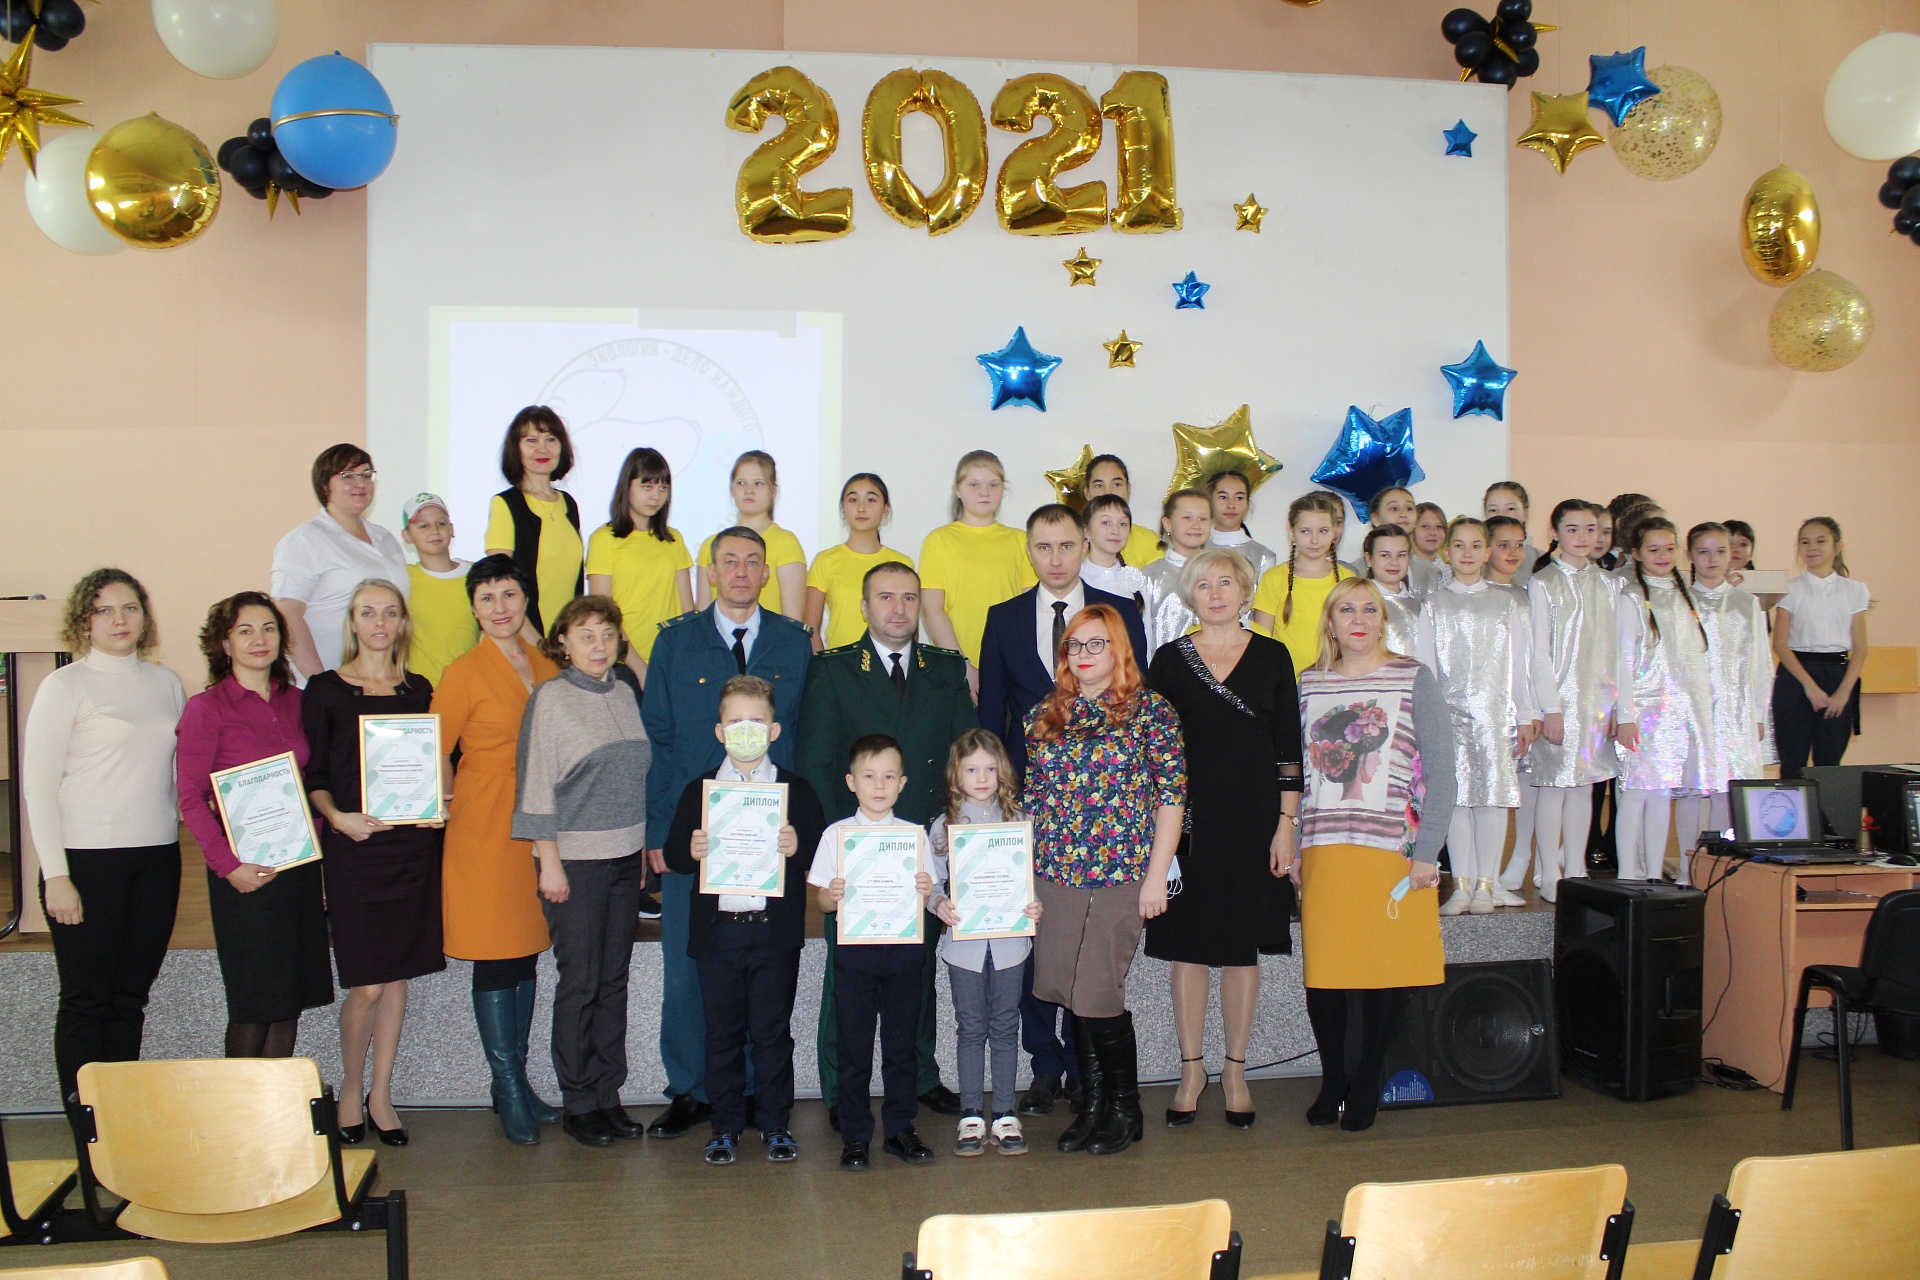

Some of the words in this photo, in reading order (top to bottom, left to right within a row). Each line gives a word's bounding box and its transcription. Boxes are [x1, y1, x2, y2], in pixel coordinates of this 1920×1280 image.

[725, 66, 1184, 244] 2021
[587, 340, 659, 368] ЭКОЛОГИЯ
[670, 346, 711, 375] ДЕЛО
[711, 372, 758, 433] КАЖДОГО
[383, 727, 433, 735] ДАРНОСТЬ
[238, 768, 290, 787] БЛАГОДАРНОСТЬ
[743, 797, 779, 807] ДИПЛОМ
[879, 842, 915, 852] ДИПЛОМ
[988, 837, 1023, 848] ДИПЛОМ
